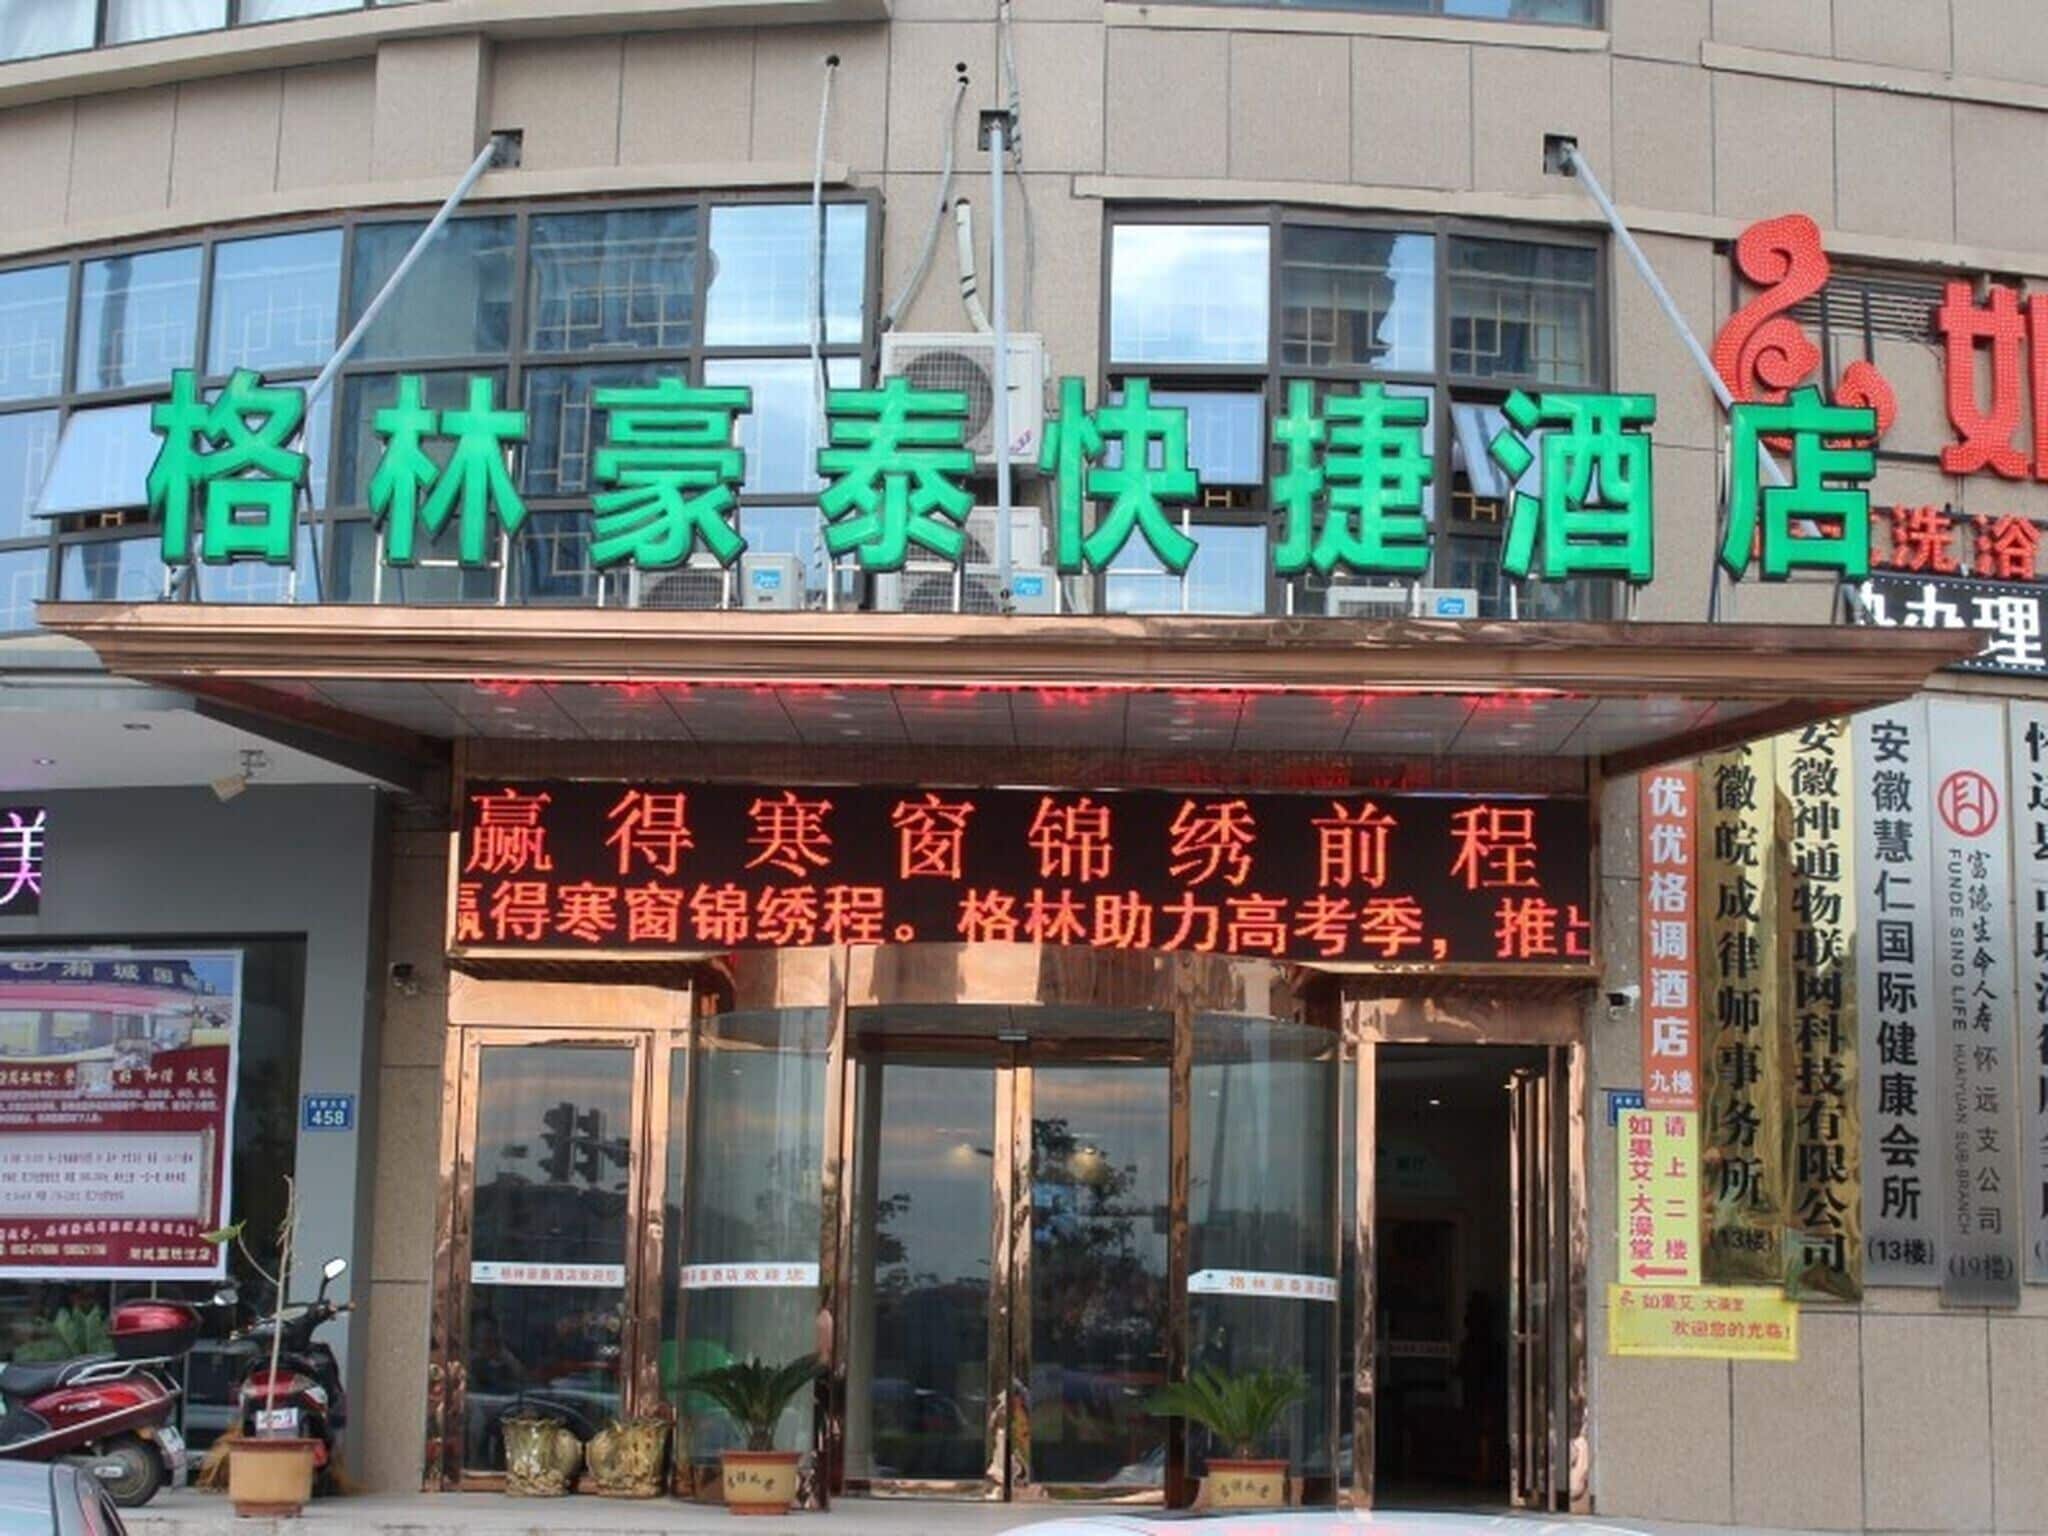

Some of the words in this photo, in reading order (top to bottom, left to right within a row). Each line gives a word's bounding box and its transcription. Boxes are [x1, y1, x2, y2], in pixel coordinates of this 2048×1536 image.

[145, 369, 1878, 582] 格林豪泰快捷酒店
[1872, 503, 2041, 580] 洗浴
[465, 787, 1541, 891] 赢得寒窗锦绣前程
[1948, 848, 1964, 918] FUNDE
[1648, 776, 1690, 1057] 优优格调酒店
[1950, 928, 1965, 977] SINO
[1713, 743, 1763, 1206] 徽皖成律师事务所
[1870, 719, 1921, 1221] 安徽慧仁国际健康会所
[1952, 985, 1967, 1031] LIFE
[311, 1110, 345, 1125] 458
[1664, 1116, 1688, 1260] 请上二楼
